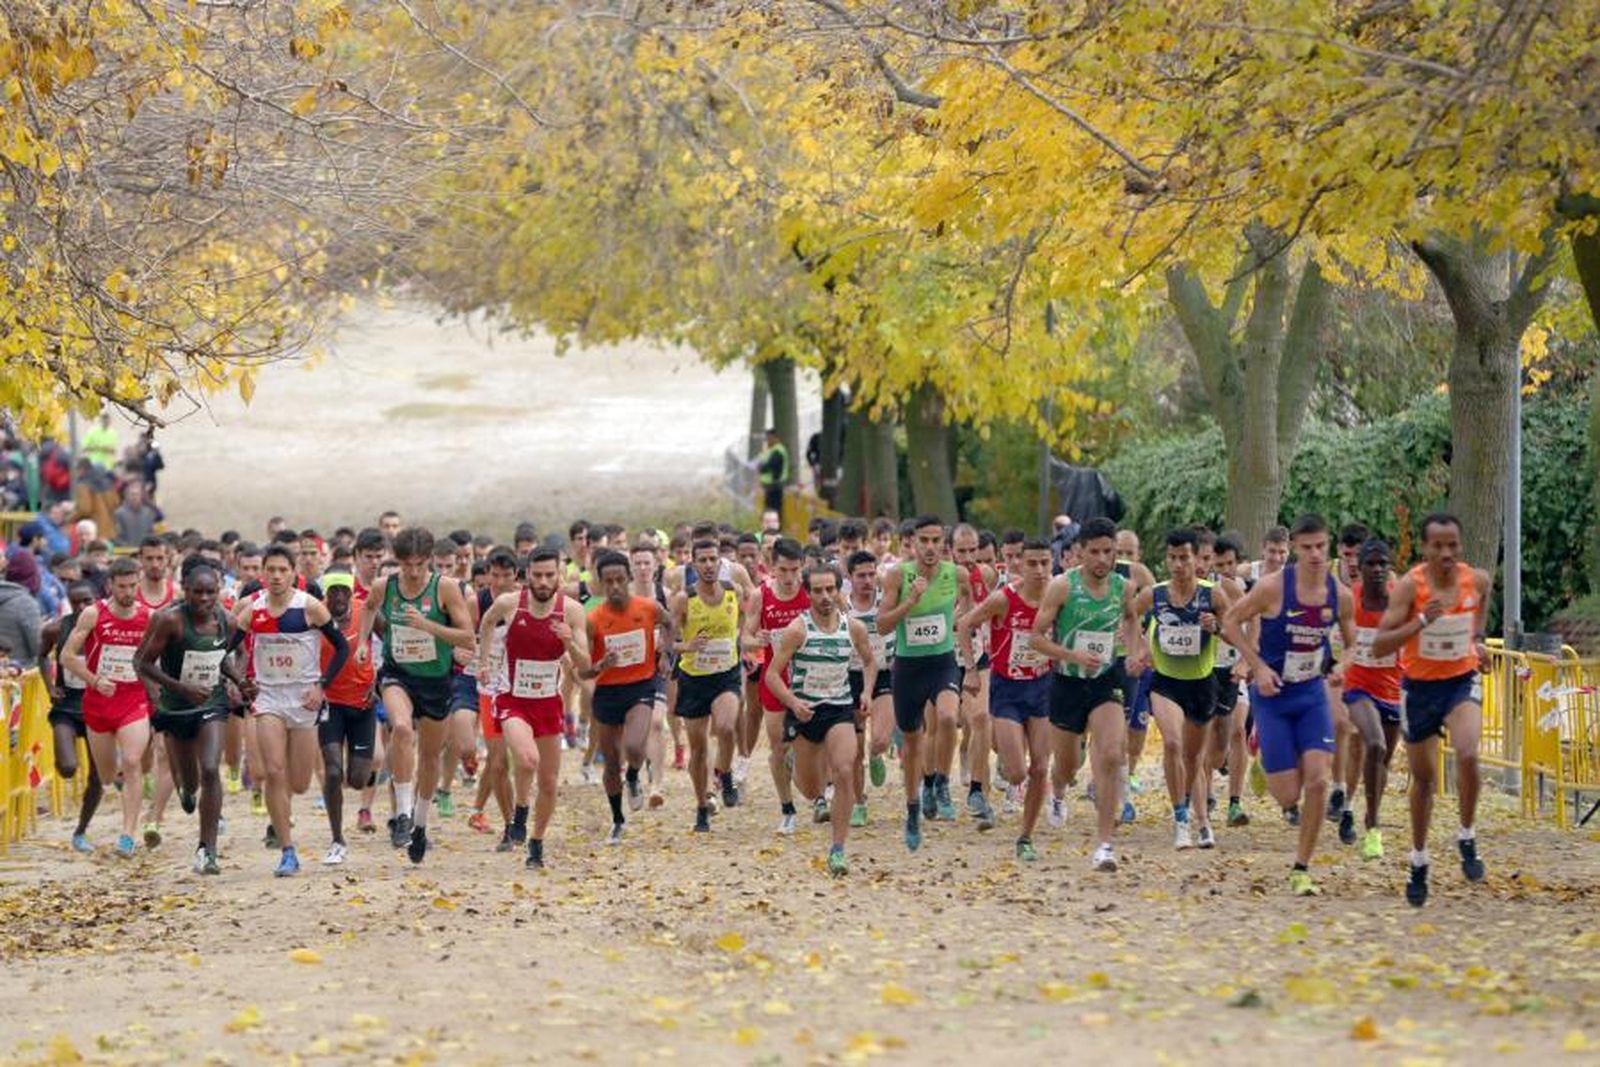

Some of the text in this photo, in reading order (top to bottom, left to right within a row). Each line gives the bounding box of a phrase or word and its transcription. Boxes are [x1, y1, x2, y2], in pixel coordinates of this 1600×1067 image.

[915, 625, 939, 637] 452
[1167, 636, 1193, 646] 449
[1087, 642, 1105, 654] 90
[268, 656, 293, 667] 150
